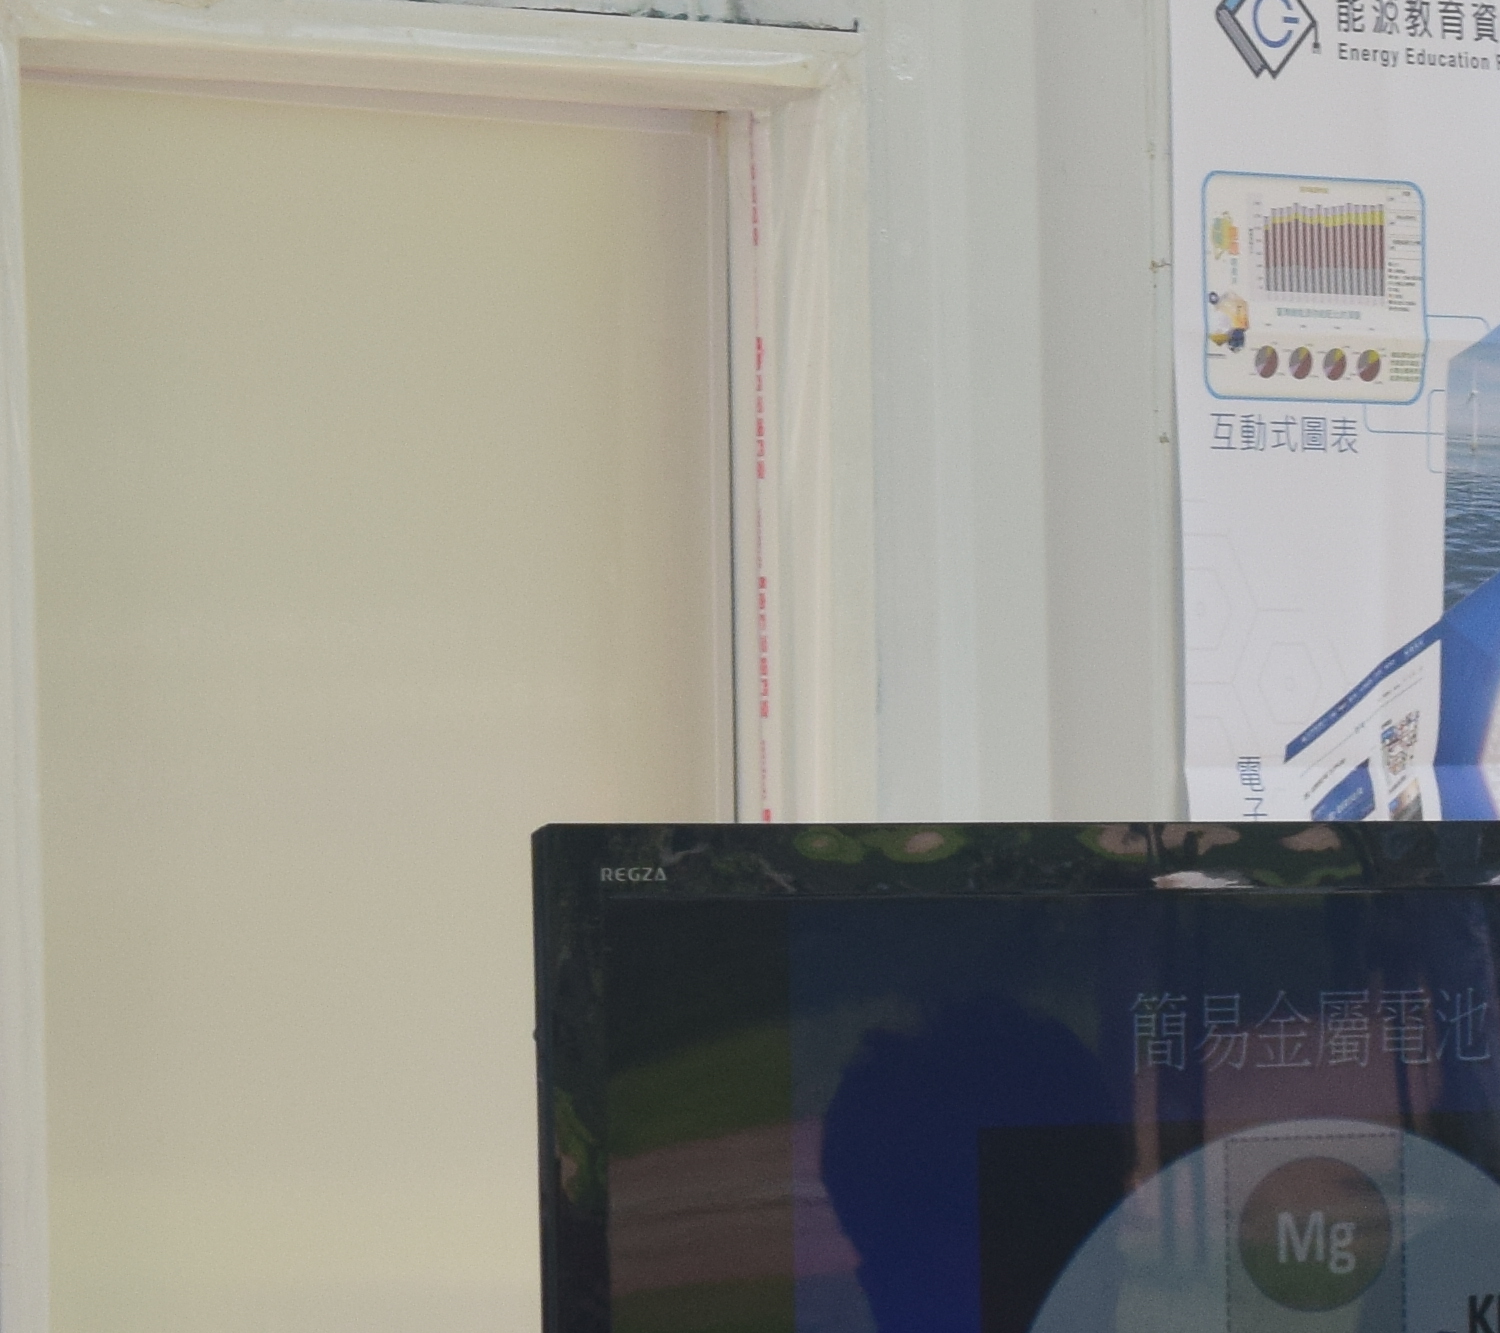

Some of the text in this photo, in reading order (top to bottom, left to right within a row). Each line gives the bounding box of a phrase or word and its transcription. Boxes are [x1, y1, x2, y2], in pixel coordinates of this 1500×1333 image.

[1338, 42, 1399, 68] Energy
[1406, 47, 1491, 71] Education
[1209, 411, 1359, 455] 互動式圖表
[600, 866, 667, 882] REGZA
[1129, 986, 1493, 1075] 簡易金屬電池
[1277, 1210, 1357, 1275] Mg
